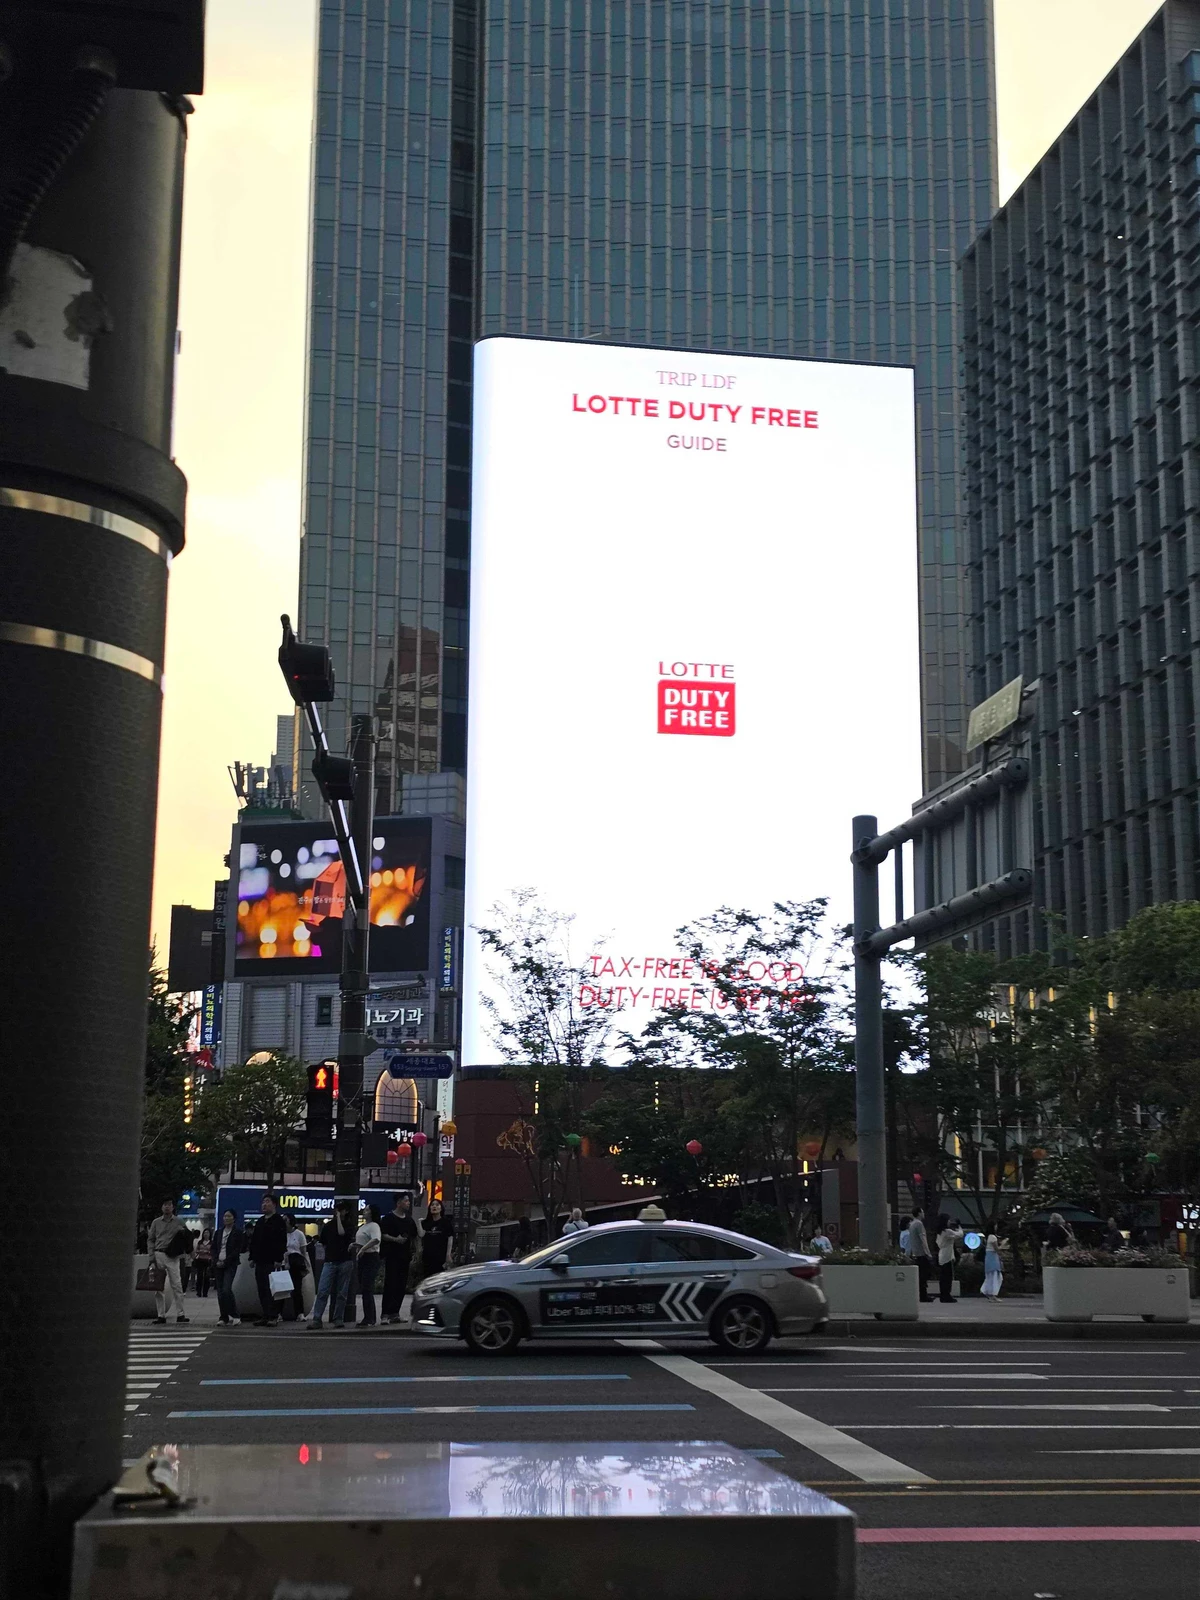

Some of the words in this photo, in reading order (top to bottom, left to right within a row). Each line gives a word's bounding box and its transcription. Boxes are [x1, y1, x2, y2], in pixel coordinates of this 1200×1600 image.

[656, 370, 697, 387] TRIP
[701, 373, 737, 390] LDF
[572, 393, 660, 418] LOTTE
[669, 400, 743, 424] DUTY
[751, 406, 820, 430] FREE
[667, 434, 728, 452] GUIDE
[659, 661, 735, 680] LOTTE
[664, 688, 730, 707] DUTY
[664, 708, 730, 728] FREE
[590, 955, 695, 979] TAX-FREE
[730, 960, 804, 982] GOOD
[579, 984, 702, 1010] DUTY-FREE
[710, 987, 728, 1010] IS
[406, 1057, 436, 1066] 세종대로
[380, 1127, 415, 1143] 녀김밥
[547, 1308, 572, 1317] Uber
